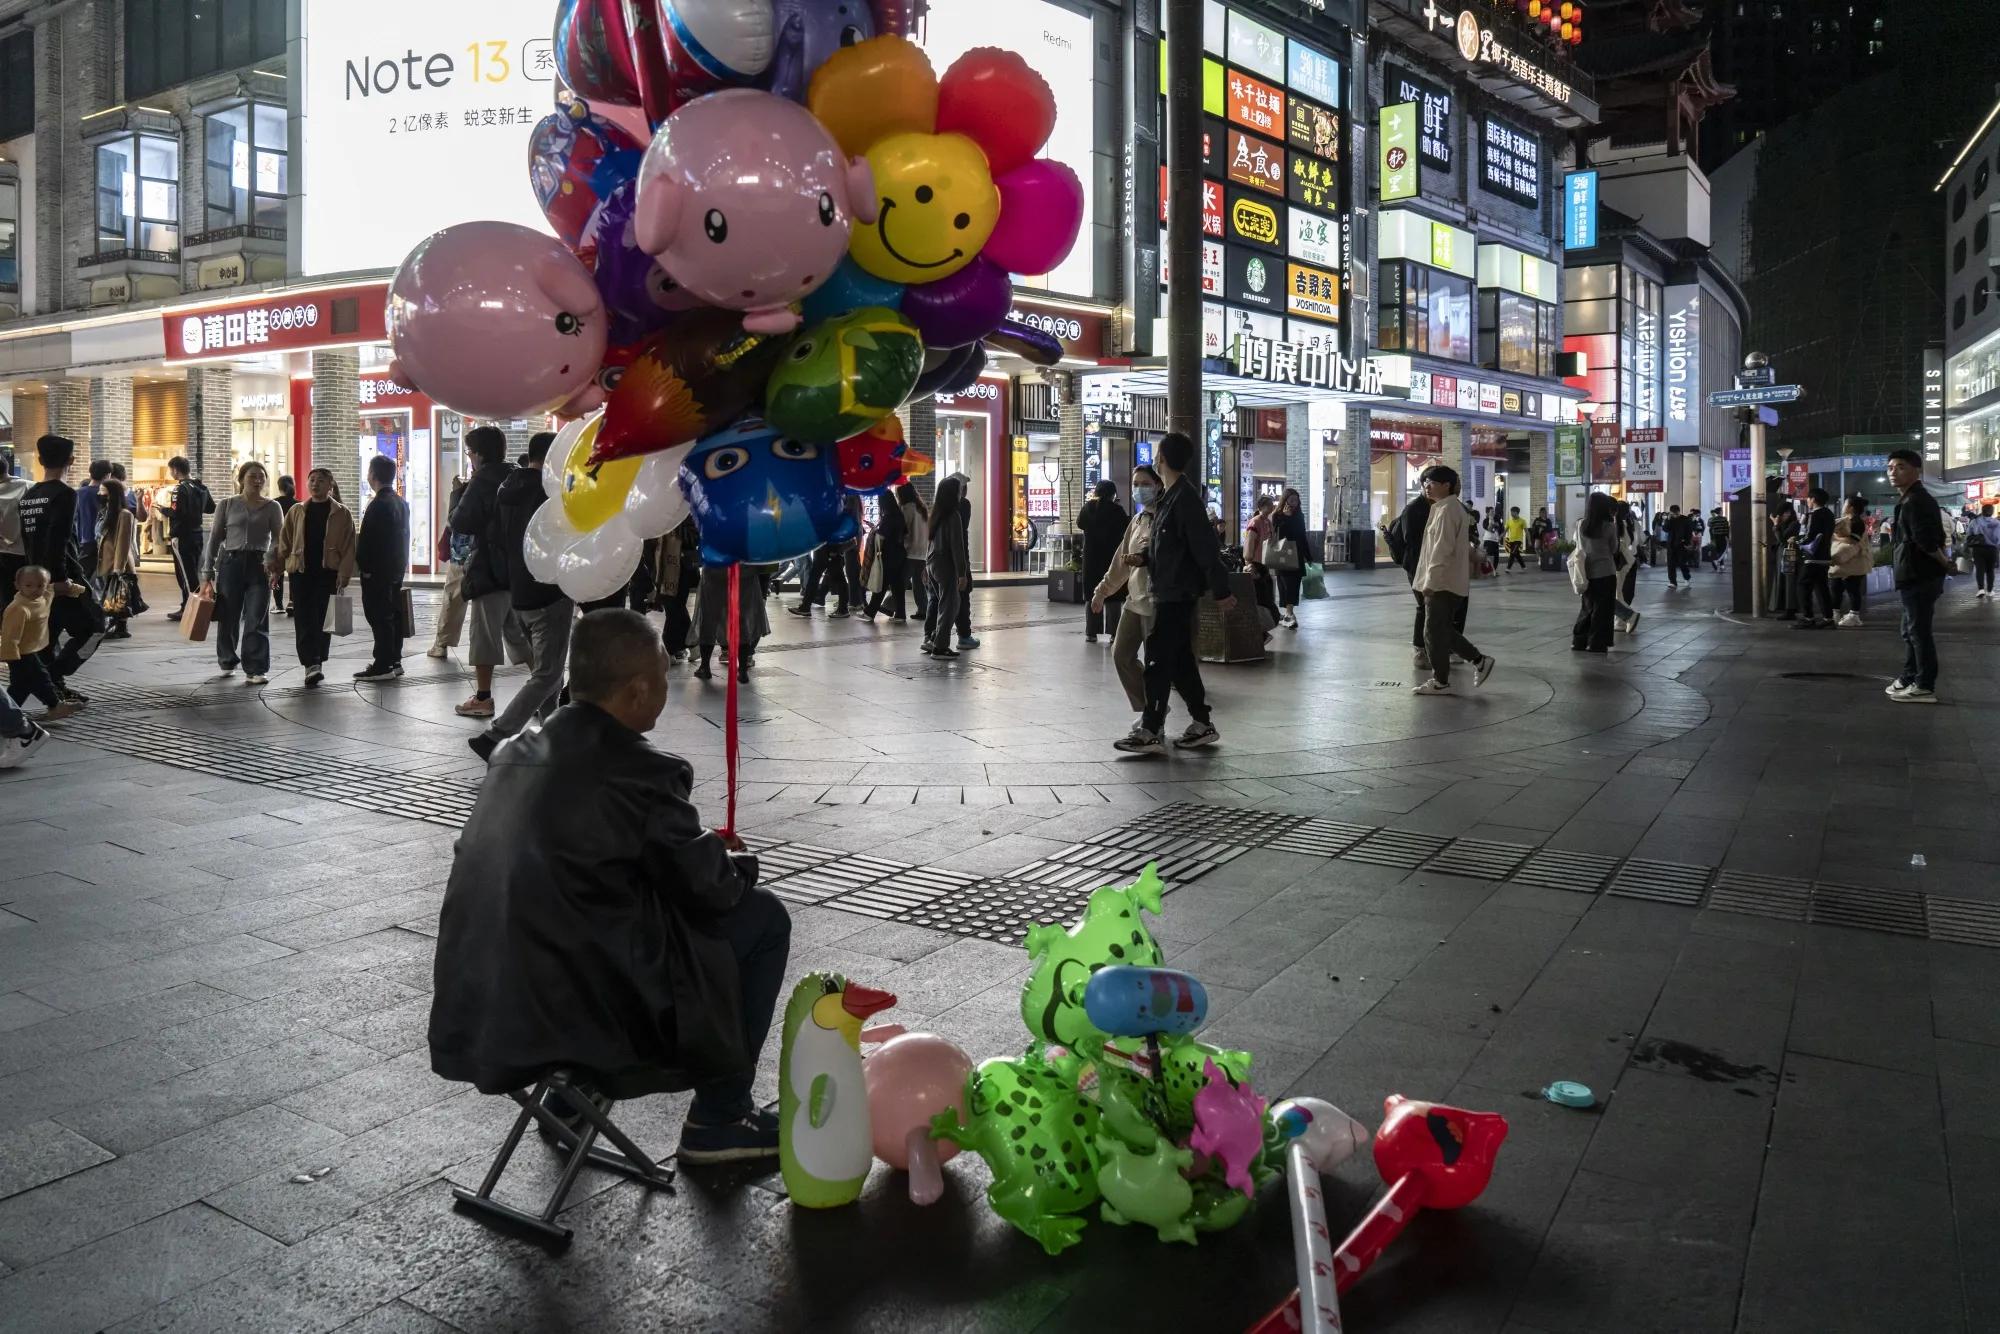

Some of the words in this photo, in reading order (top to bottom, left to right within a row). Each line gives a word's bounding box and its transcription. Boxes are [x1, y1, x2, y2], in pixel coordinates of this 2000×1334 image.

[1043, 30, 1072, 50] Redmi
[346, 49, 455, 101] Note
[466, 41, 510, 83] 13
[534, 49, 554, 70] 系
[1491, 41, 1571, 103] 椰子鸡音乐主题餐厅
[1241, 105, 1272, 129] 请上2楼
[1289, 97, 1296, 107] 3F
[389, 118, 397, 134] 2
[403, 112, 449, 133] 亿像素
[464, 106, 534, 127] 蜕变新生
[1422, 135, 1449, 162] 助餐厅
[1487, 120, 1512, 151] 国际美食
[1513, 134, 1537, 163] 无限享用
[1487, 146, 1512, 171] 海鲜火锅
[1514, 158, 1537, 182] 铁板烧
[1124, 142, 1133, 237] HONGZHAN
[1487, 164, 1512, 189] 西餐牛排
[1514, 176, 1537, 199] 日韩料理
[1574, 176, 1589, 205] 领鲜
[1342, 213, 1350, 290] HONGZHAN
[1242, 292, 1271, 305] STARBUCKS
[1295, 270, 1332, 301] 吉野家
[1296, 297, 1332, 315] YOSHINOYA
[204, 309, 270, 350] 莆田鞋
[1239, 334, 1383, 395] 鸿展中心城
[377, 380, 413, 395] 大牌
[1740, 392, 1763, 401] 人民北路
[1926, 369, 1941, 434] SEMIR
[1381, 431, 1390, 439] TAI
[1391, 432, 1404, 440] FOOK
